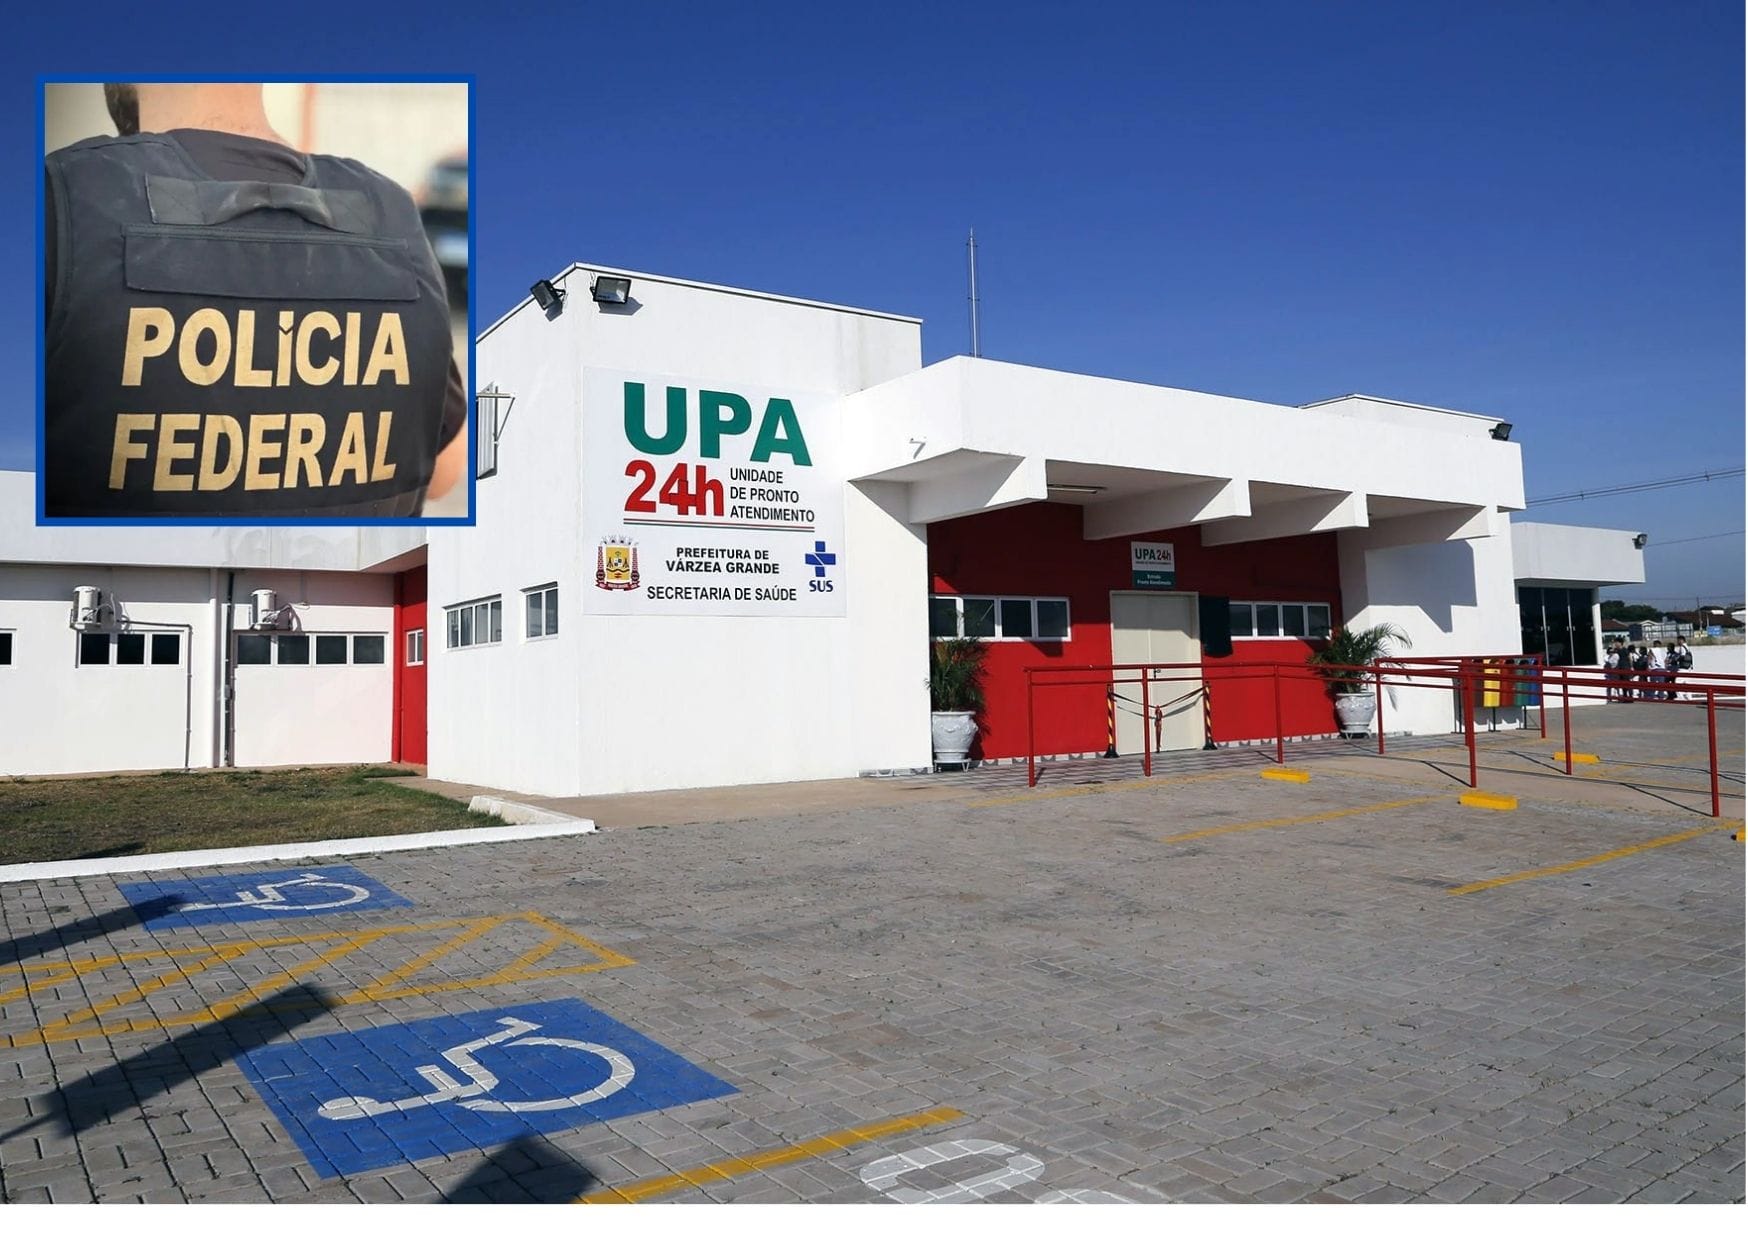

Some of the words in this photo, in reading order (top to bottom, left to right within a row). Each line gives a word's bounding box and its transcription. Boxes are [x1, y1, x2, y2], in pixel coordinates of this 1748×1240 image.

[624, 381, 813, 466] UPA
[109, 411, 397, 491] FEDERAL
[730, 468, 783, 484] UNIDADE
[624, 459, 724, 516] 24h
[730, 486, 747, 500] DE
[750, 488, 799, 503] PRONTO
[730, 505, 815, 522] ATENDIMENTO
[676, 547, 752, 560] PREFEITURA
[754, 550, 769, 560] DE
[1135, 548, 1155, 560] UPA
[666, 558, 722, 573] VÁRZEA
[726, 561, 780, 574] GRANDE
[647, 586, 731, 601] SECRETARIA
[734, 587, 751, 601] DE
[755, 585, 797, 601] SAÚDE
[808, 580, 834, 593] SUS
